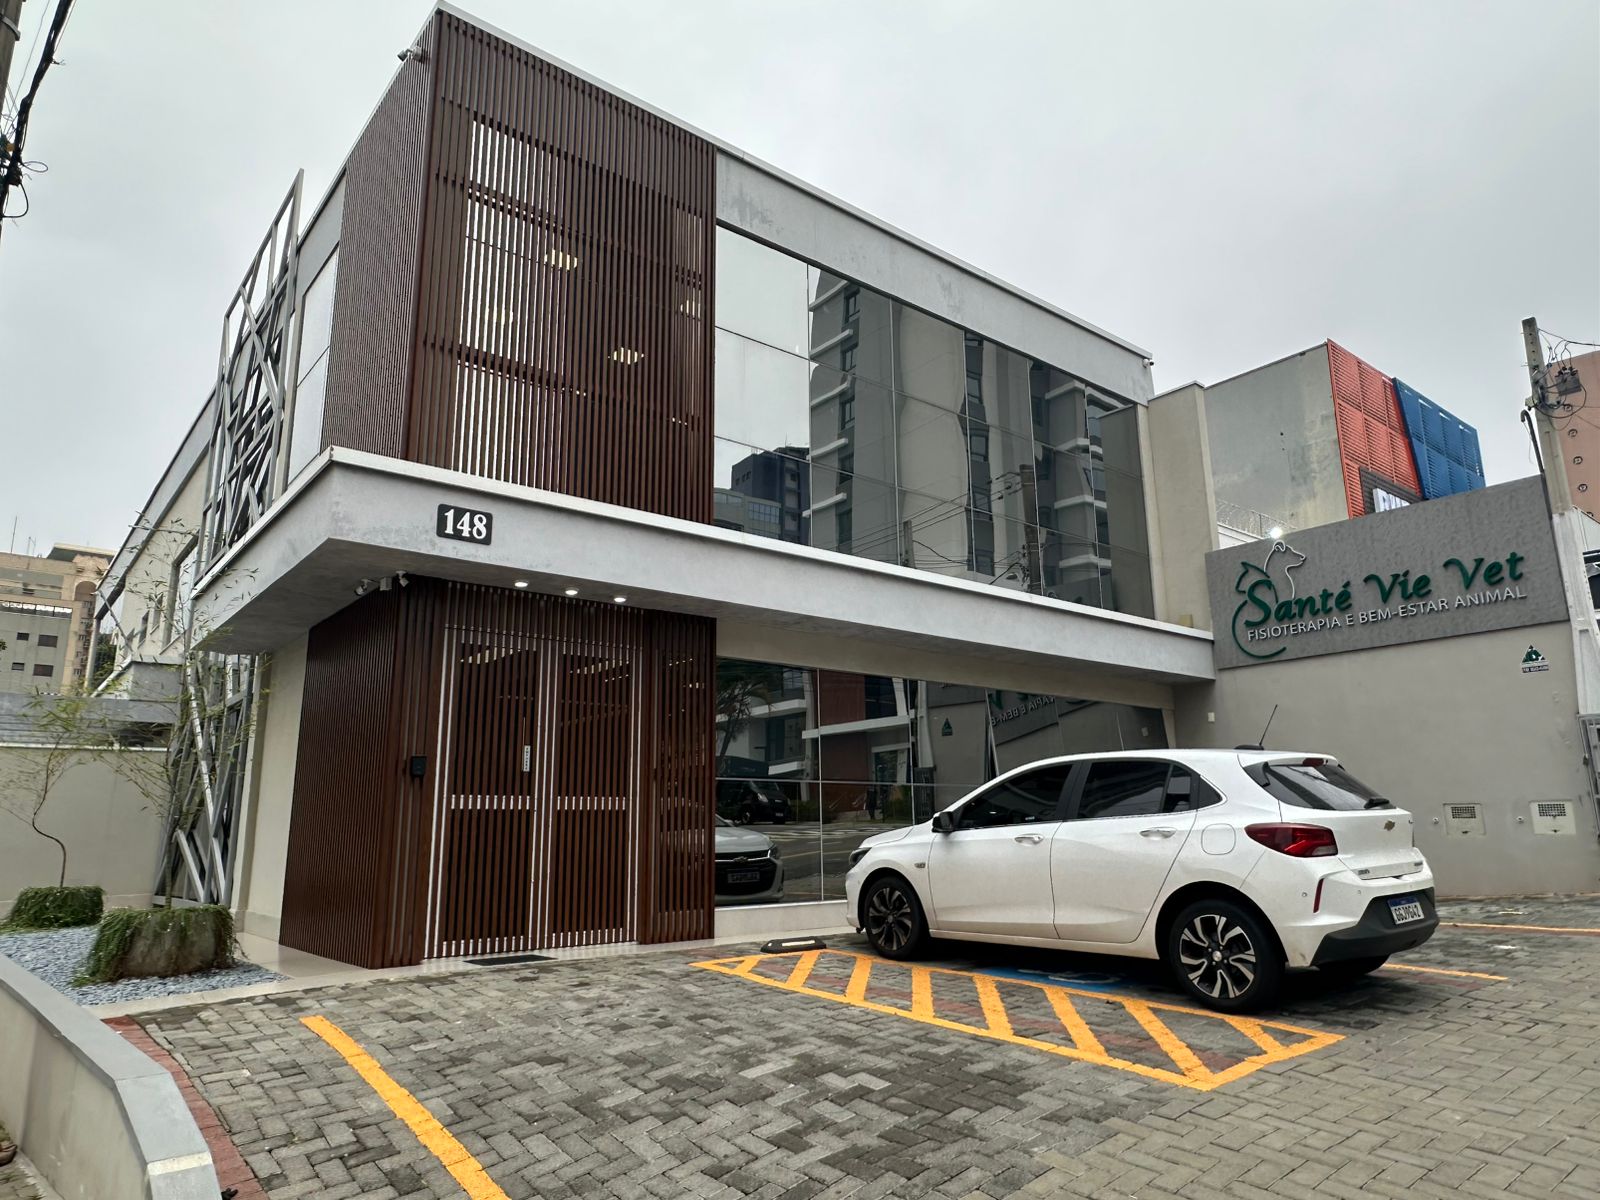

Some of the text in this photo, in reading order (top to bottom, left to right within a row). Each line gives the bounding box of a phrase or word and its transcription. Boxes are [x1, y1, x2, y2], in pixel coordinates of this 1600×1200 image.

[444, 508, 487, 540] 148
[1244, 551, 1524, 628] Santé Vie Vet
[1247, 585, 1528, 642] FISIOTERAPIA E BEM-ESTAR ANIMAL
